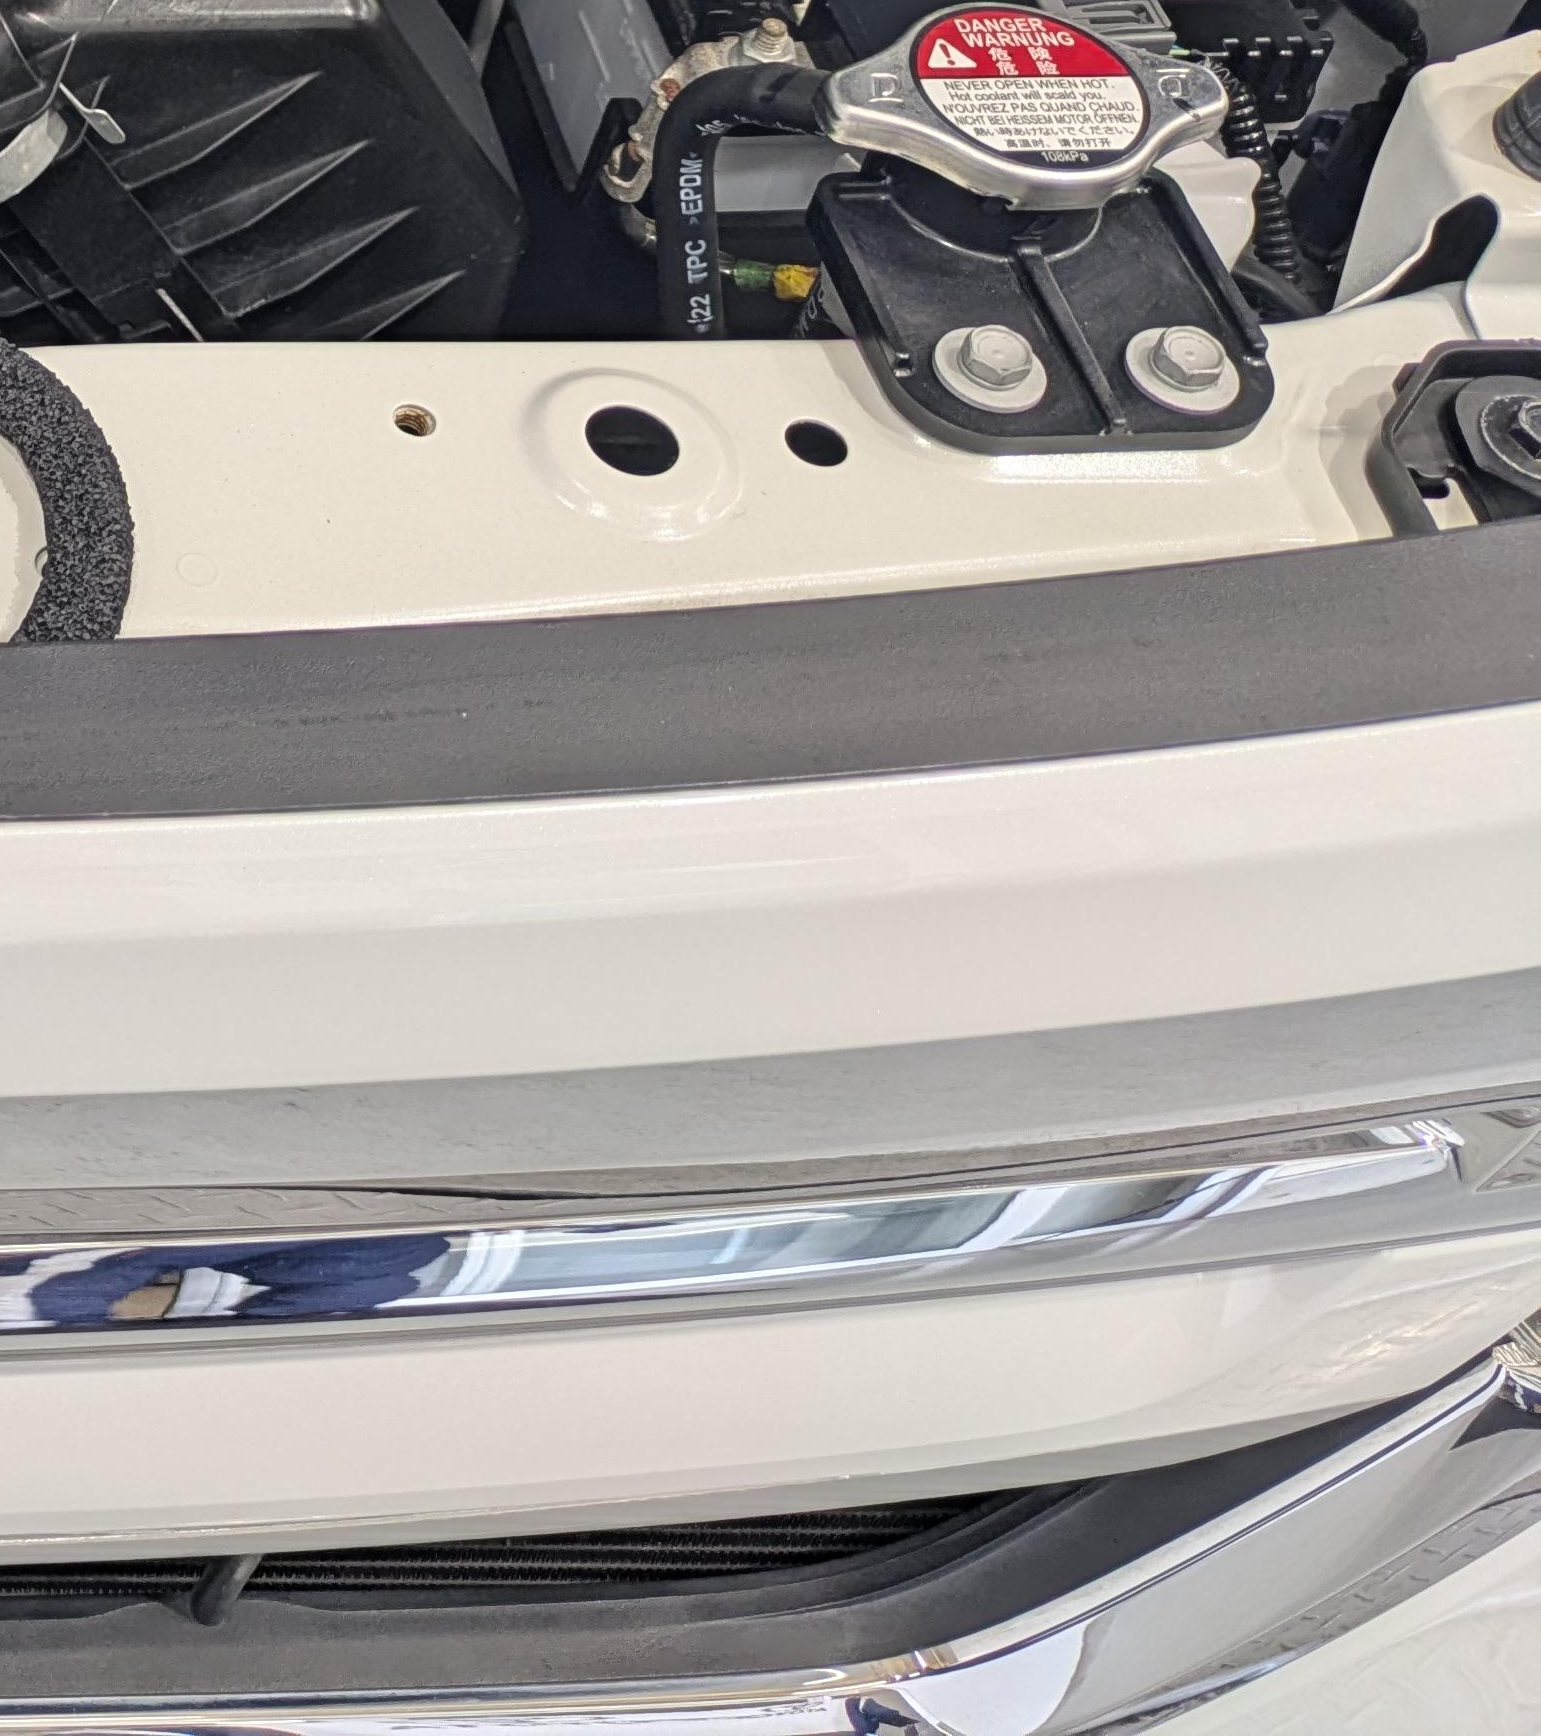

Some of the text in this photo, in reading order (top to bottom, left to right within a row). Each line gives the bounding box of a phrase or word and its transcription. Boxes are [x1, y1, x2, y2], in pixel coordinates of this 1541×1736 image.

[954, 18, 1047, 33] DANGER
[960, 32, 1075, 47] WARNUNG
[943, 78, 1116, 91] NEVER OPEN WHEN HOT.
[950, 90, 1106, 103] Hot coolant will scald you.
[942, 101, 1140, 114] N'OUVREZ PAS QUAND CHAUD.
[955, 115, 986, 125] NICHT
[989, 115, 1006, 125] BEI
[1008, 114, 1053, 125] HEISSEM
[1055, 114, 1093, 124] MOTOR
[1041, 151, 1089, 163] 108kPa
[684, 239, 709, 284] TPC
